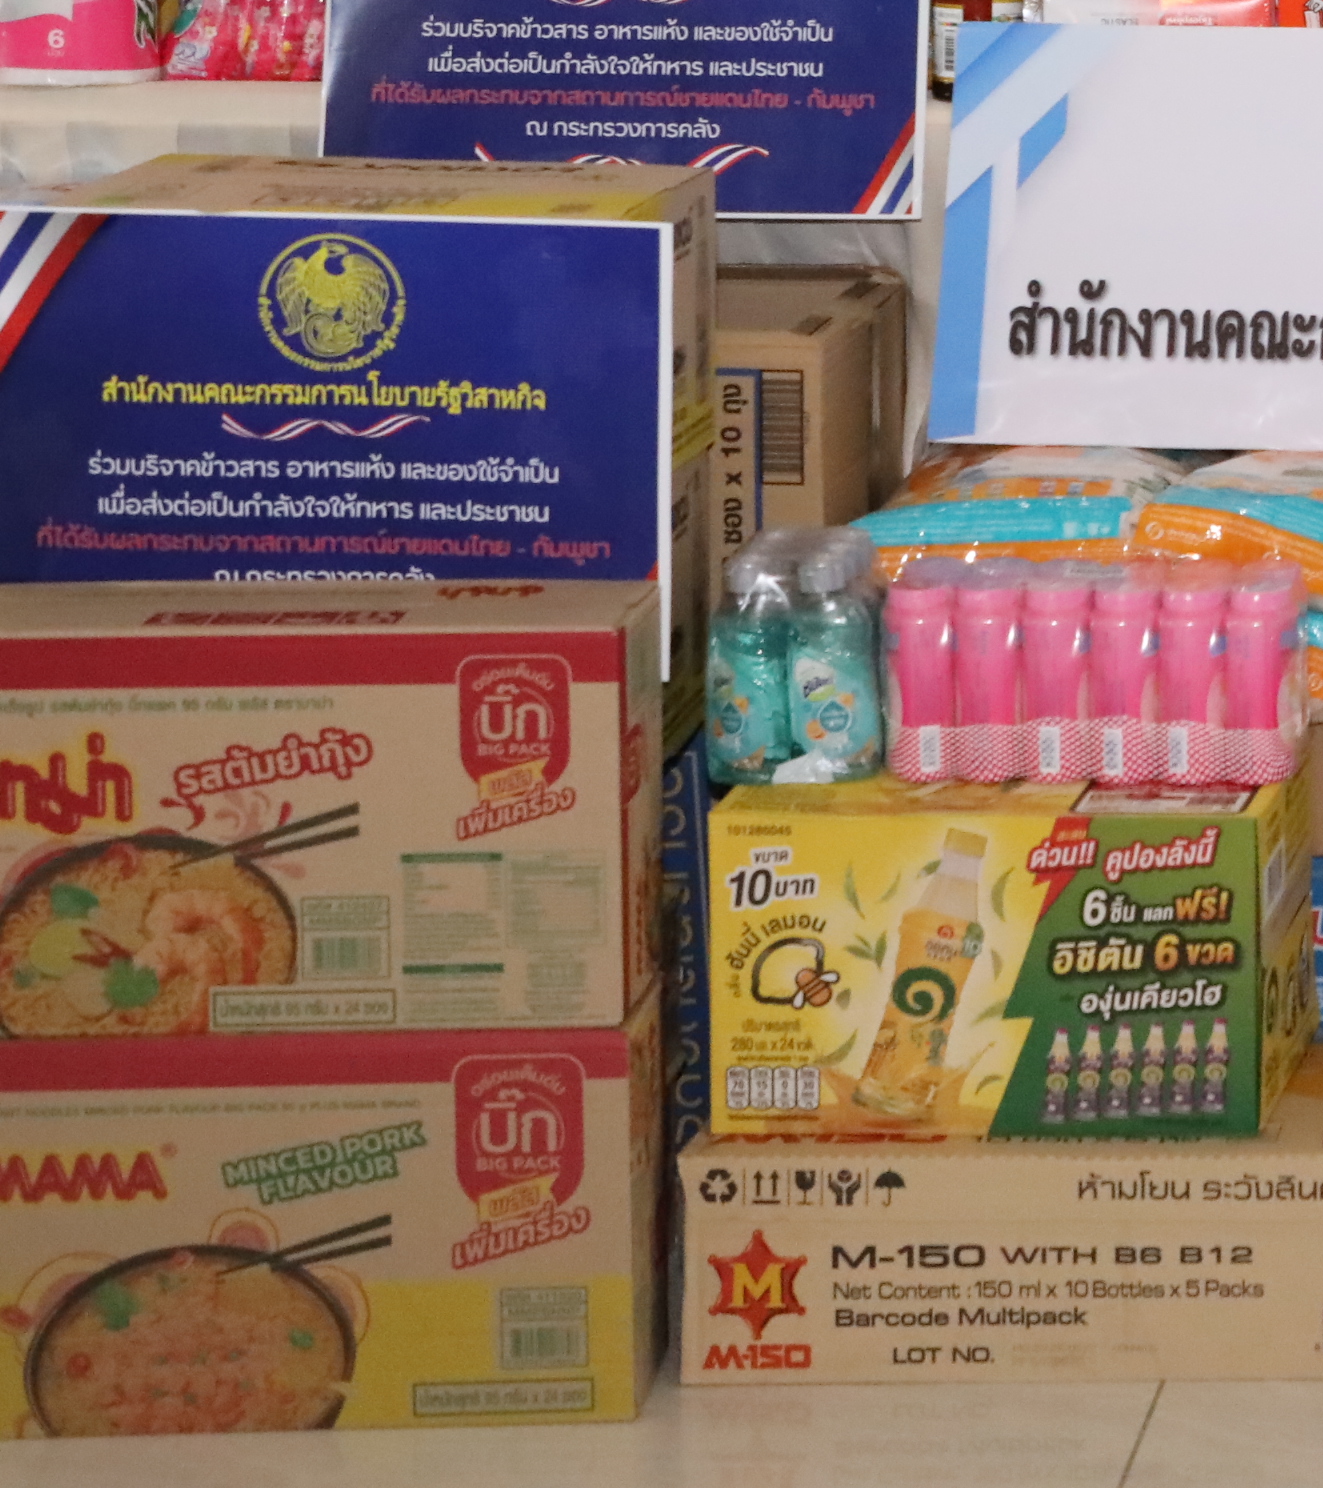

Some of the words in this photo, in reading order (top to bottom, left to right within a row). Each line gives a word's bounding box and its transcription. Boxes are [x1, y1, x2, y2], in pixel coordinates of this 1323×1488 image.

[47, 29, 65, 49] 6
[421, 15, 589, 41] ร่วมบริจาคข้าวสาร
[594, 18, 689, 42] อาหารแห้ง
[694, 19, 834, 44] และของใช้จำเป็น
[428, 50, 703, 77] เพื่อส่งต่อเป็นกำลังใจให้ทหาร
[709, 57, 824, 78] และประชาชน
[807, 90, 875, 118] กัมพูชา
[525, 119, 548, 139] ณ
[553, 117, 721, 140] กระทรวงการคลัง
[102, 371, 547, 415] สำนักงานคณะกรรมการนโยบายรัฐวิสาหกิจ
[721, 425, 742, 459] 10
[88, 453, 280, 480] ร่วมบริจาคข้าวสาร
[286, 455, 396, 482] อาหารแห้ง
[400, 456, 560, 486] และของใช้จำเป็น
[98, 485, 414, 521] เพื่อส่งต่อเป็นกำลังใจให้ทหาร
[419, 499, 550, 524] และประชาชน
[722, 497, 743, 546] ซอง
[531, 538, 611, 568] กัมพูชา
[479, 683, 548, 742] บิ๊ก
[176, 728, 373, 798] รสต้มยำกุ้ง
[476, 743, 505, 756] BIG
[509, 743, 551, 755] PACK
[457, 781, 577, 841] เพิ่มเครื่อง
[752, 850, 789, 864] ขนาด
[1029, 840, 1097, 872] ด่วน!!
[1104, 828, 1219, 880] คูปองลังนี้
[1083, 889, 1107, 927] 6
[1109, 895, 1137, 923] ชิ้น
[1174, 887, 1229, 920] ฟรี!
[763, 912, 827, 937] เลมอน
[1052, 937, 1143, 975] อิชิตัน
[1153, 933, 1180, 970] 6
[1186, 941, 1235, 965] ขวด
[1079, 979, 1222, 1020] องุ่นเคียวโฮ
[479, 1088, 558, 1154] บิ๊ก
[223, 1142, 337, 1188] MINCED
[342, 1121, 426, 1157] PORK
[475, 1156, 508, 1173] BIG
[512, 1155, 562, 1172] PACK
[259, 1157, 399, 1205] FLAVOUR
[1078, 1172, 1192, 1204] ห้ามโยน
[452, 1199, 592, 1271] เพิ่มเครื่อง
[831, 1245, 987, 1269] M-150
[1001, 1246, 1098, 1264] WITH
[1114, 1246, 1163, 1264] B6
[730, 1262, 788, 1309] M
[832, 1281, 873, 1301] Net
[877, 1281, 962, 1300] Content
[1018, 1281, 1043, 1298] ml
[1046, 1286, 1058, 1299] x
[1065, 1281, 1089, 1299] 10
[1092, 1280, 1166, 1300] Bottles
[1169, 1286, 1182, 1299] x
[1185, 1281, 1201, 1299] 5
[1204, 1281, 1265, 1299] Packs
[834, 1307, 950, 1328] Barcode
[957, 1307, 1087, 1329] Multipack
[702, 1343, 812, 1370] M-150
[892, 1347, 940, 1364] LOT
[951, 1347, 995, 1364] NO.
